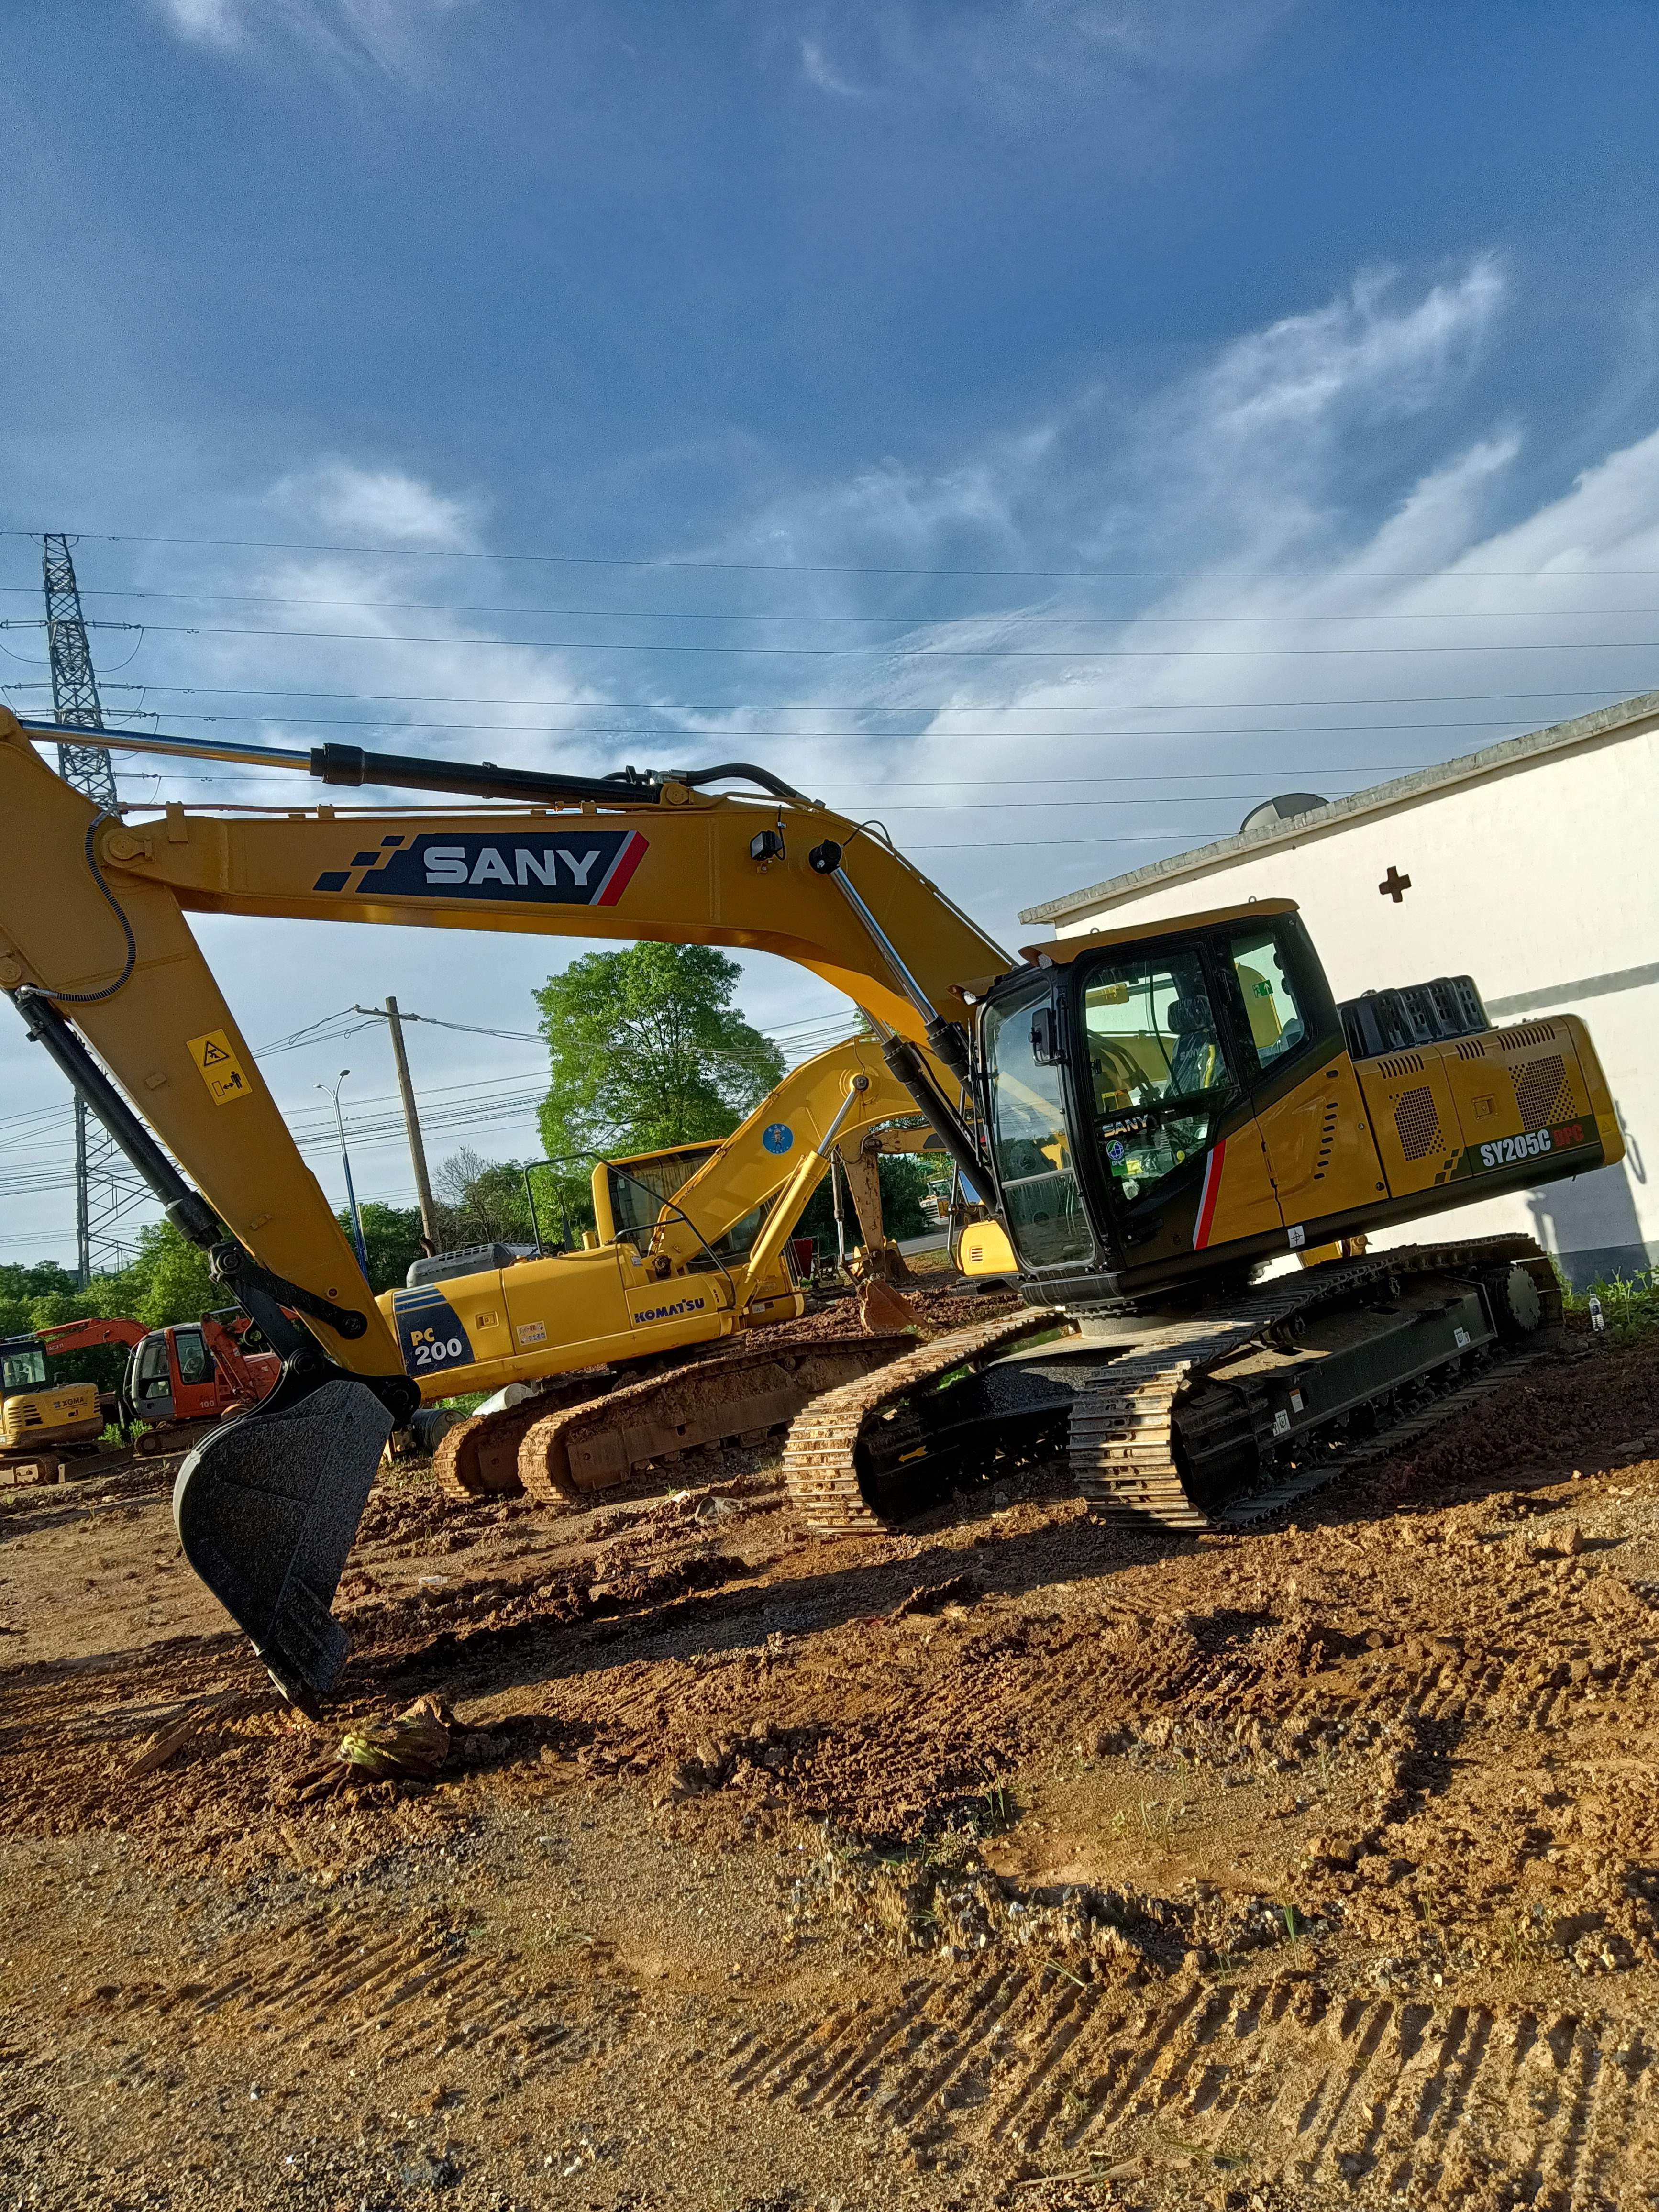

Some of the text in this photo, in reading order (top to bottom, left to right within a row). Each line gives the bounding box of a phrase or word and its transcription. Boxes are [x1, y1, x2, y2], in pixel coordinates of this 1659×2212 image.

[424, 847, 601, 885] SANY
[1102, 1114, 1149, 1138] SANY
[1480, 1129, 1551, 1167] SY205C
[634, 1297, 705, 1323] KOMATSU
[46, 1343, 64, 1352] TACHI
[411, 1327, 435, 1346] PC
[415, 1338, 462, 1365] 200
[62, 1396, 84, 1406] XGMA
